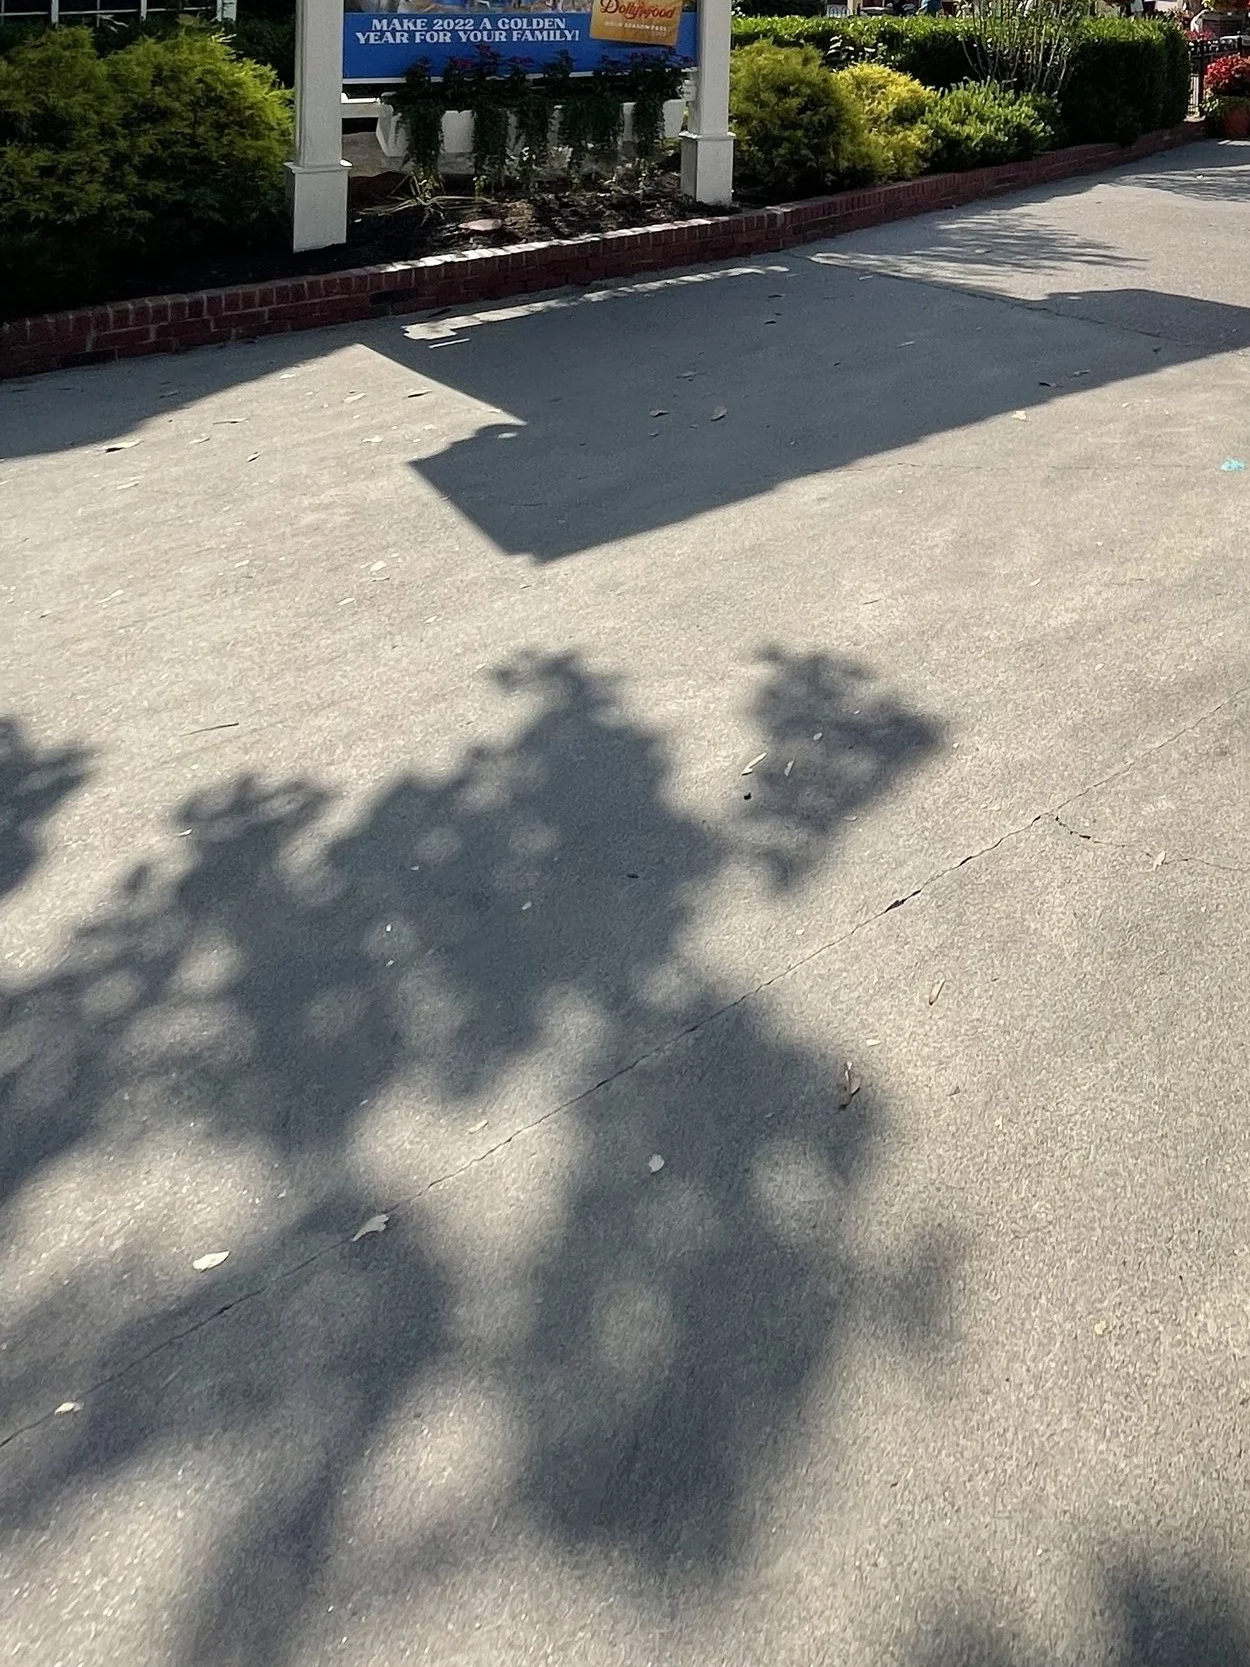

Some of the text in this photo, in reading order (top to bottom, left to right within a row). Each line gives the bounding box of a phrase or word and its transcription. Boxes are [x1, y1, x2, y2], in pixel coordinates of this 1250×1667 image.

[371, 18, 566, 31] MAKE 2022 A GOLDEN
[355, 30, 580, 44] YEAR FOR YOUR FAMILY!
